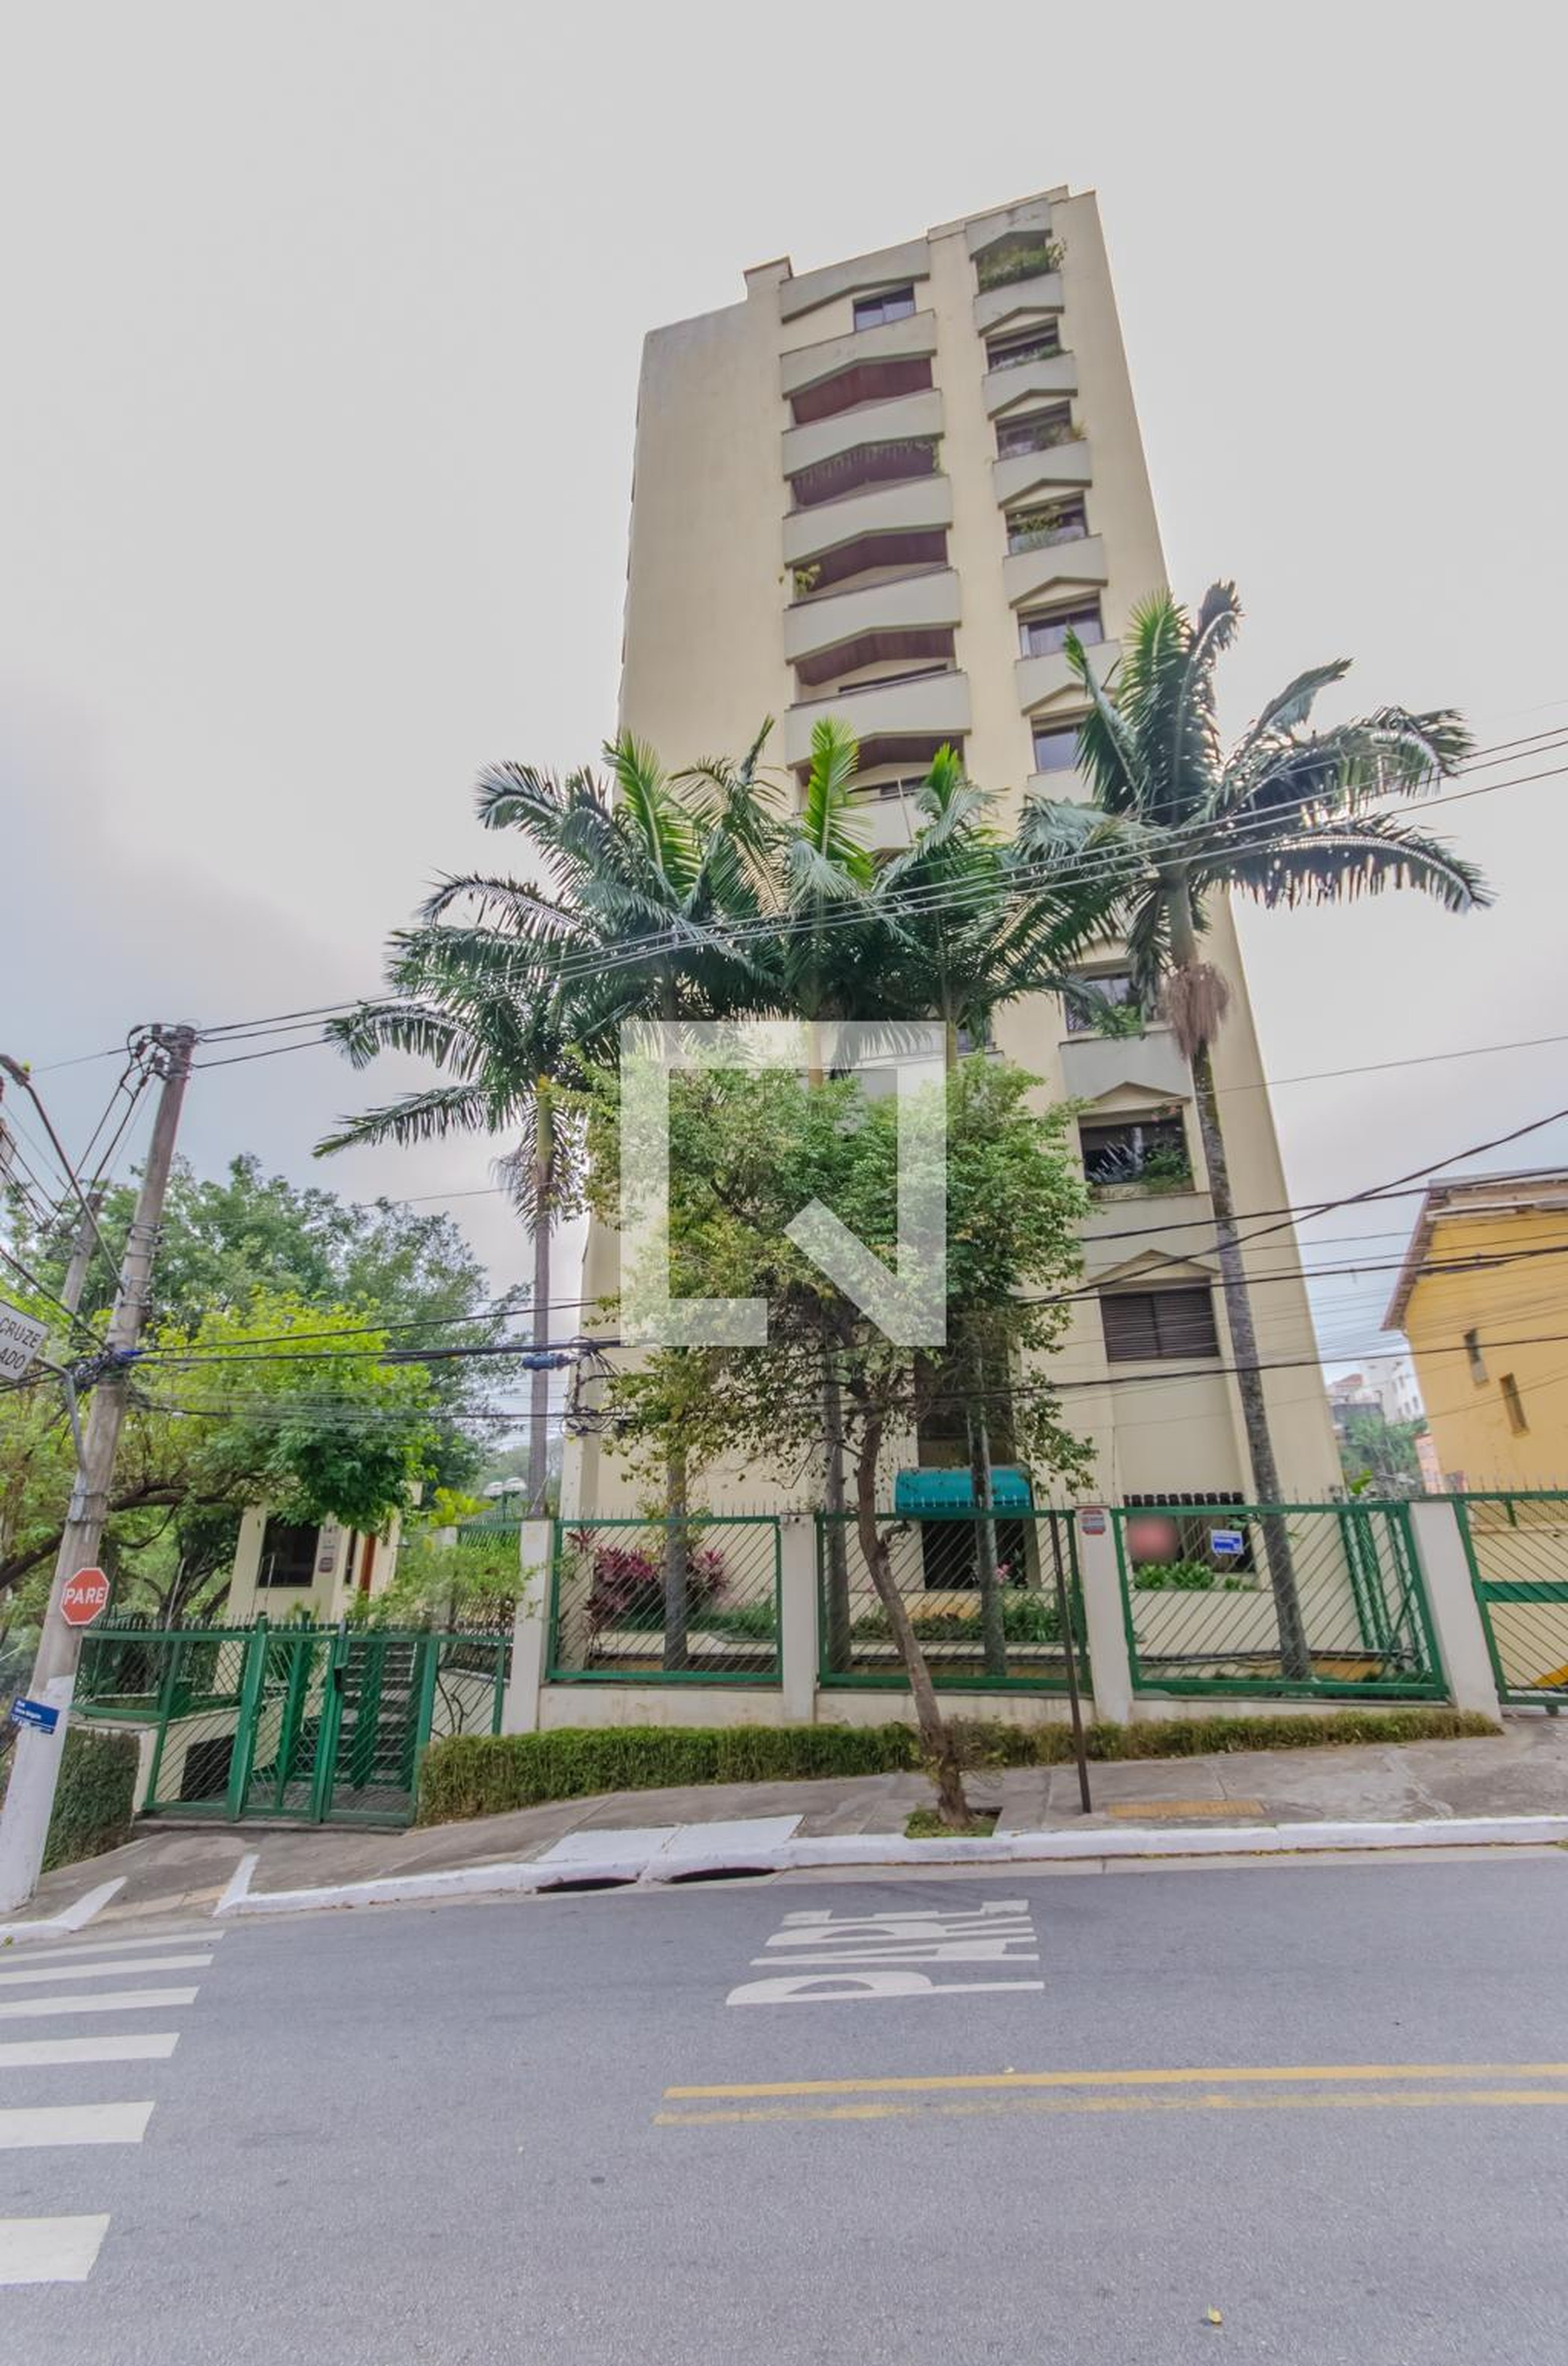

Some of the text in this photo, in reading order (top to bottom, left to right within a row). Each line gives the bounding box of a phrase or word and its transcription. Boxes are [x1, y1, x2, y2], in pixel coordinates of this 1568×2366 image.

[0, 1317, 41, 1348] CRUZE
[64, 1587, 106, 1605] PARE
[726, 1899, 1045, 2006] PARE
